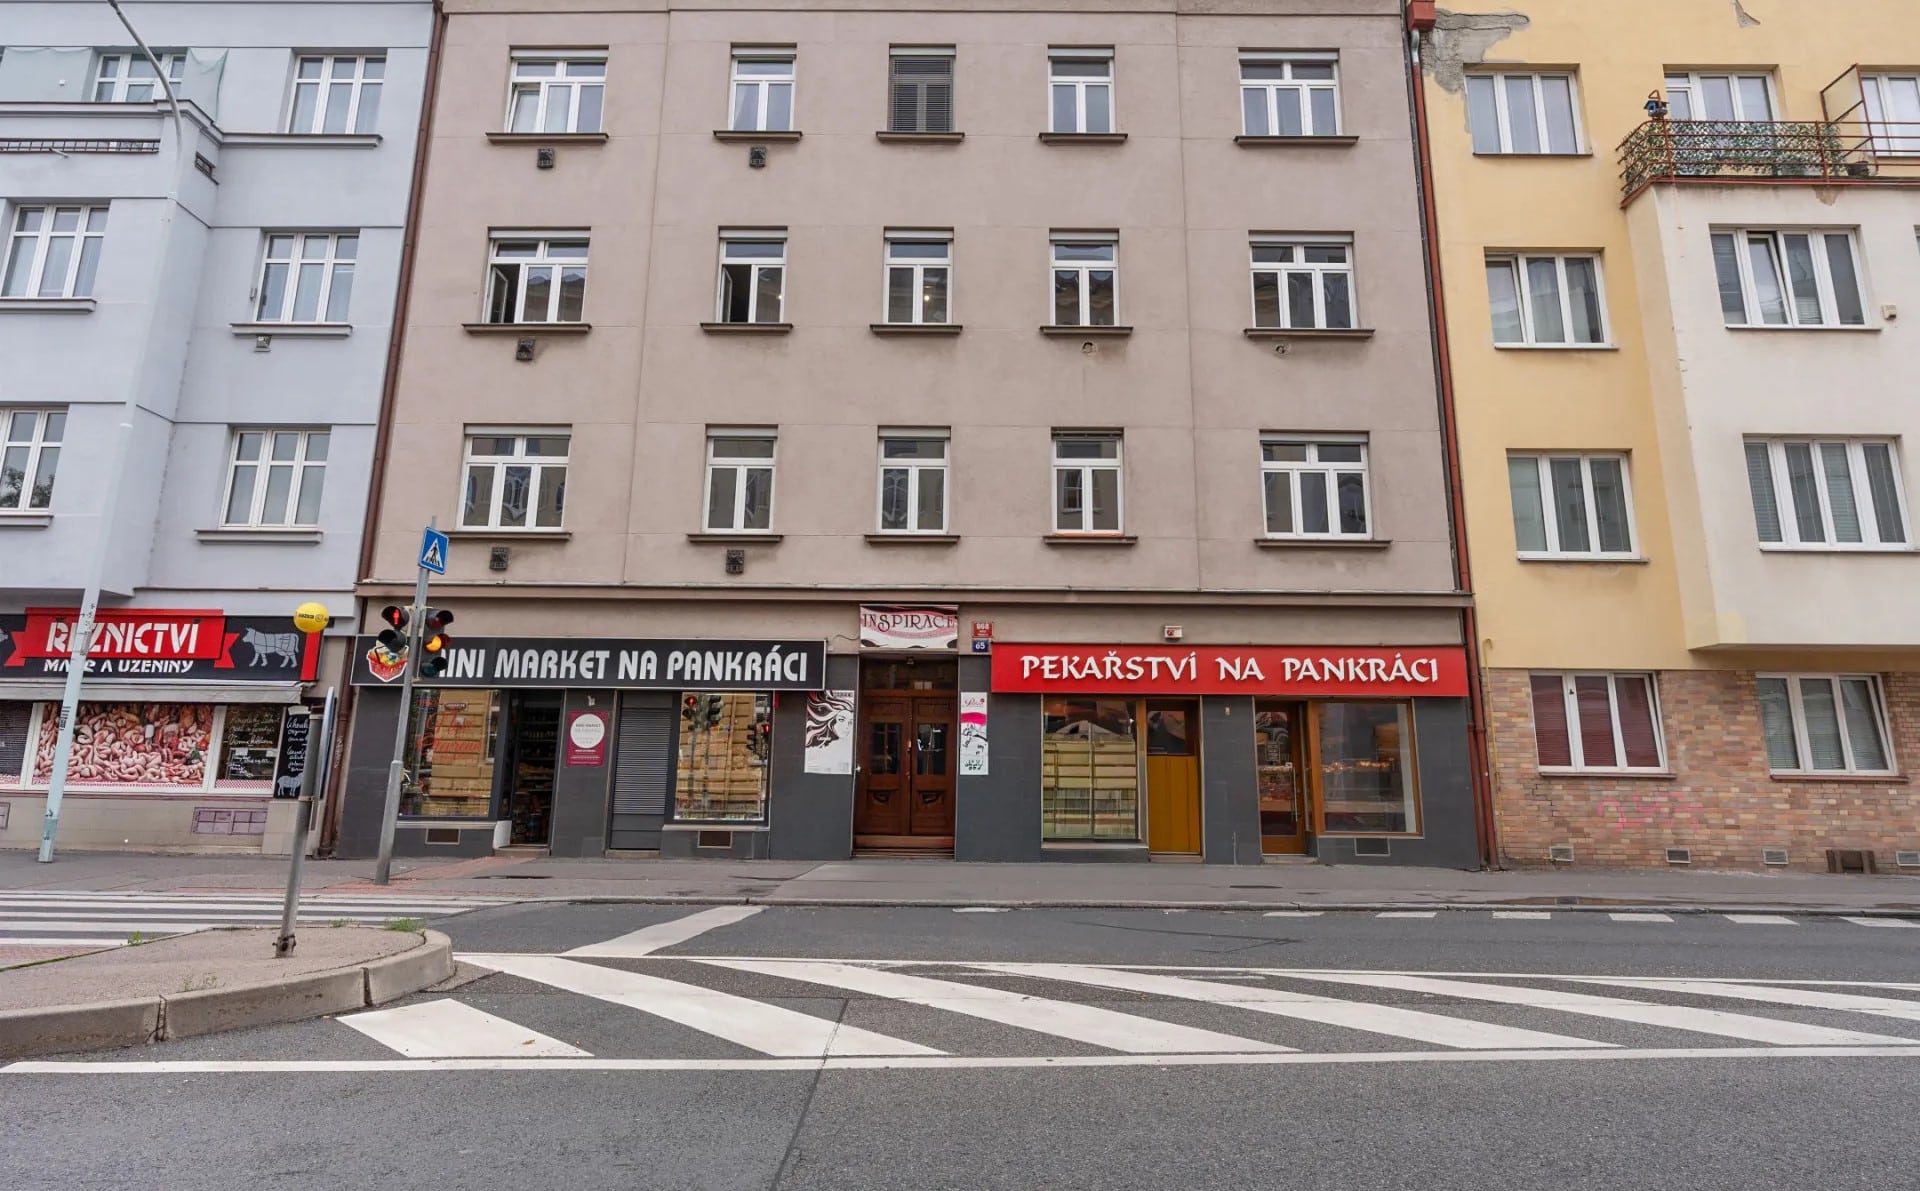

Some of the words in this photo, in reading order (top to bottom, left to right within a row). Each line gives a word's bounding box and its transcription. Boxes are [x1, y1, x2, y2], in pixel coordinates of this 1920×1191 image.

[863, 614, 954, 632] INSPIRACE
[975, 641, 985, 650] 65
[44, 659, 95, 673] MA
[100, 659, 113, 673] A
[118, 659, 194, 673] UZENINY
[438, 648, 486, 679] INI
[494, 648, 610, 680] MARKET
[617, 650, 658, 681] NA
[666, 645, 808, 682] PANKRÁCI
[1020, 650, 1197, 681] PEKAŘSTVÍ
[1215, 656, 1265, 681] NA
[1281, 652, 1438, 682] PANKRÁCI
